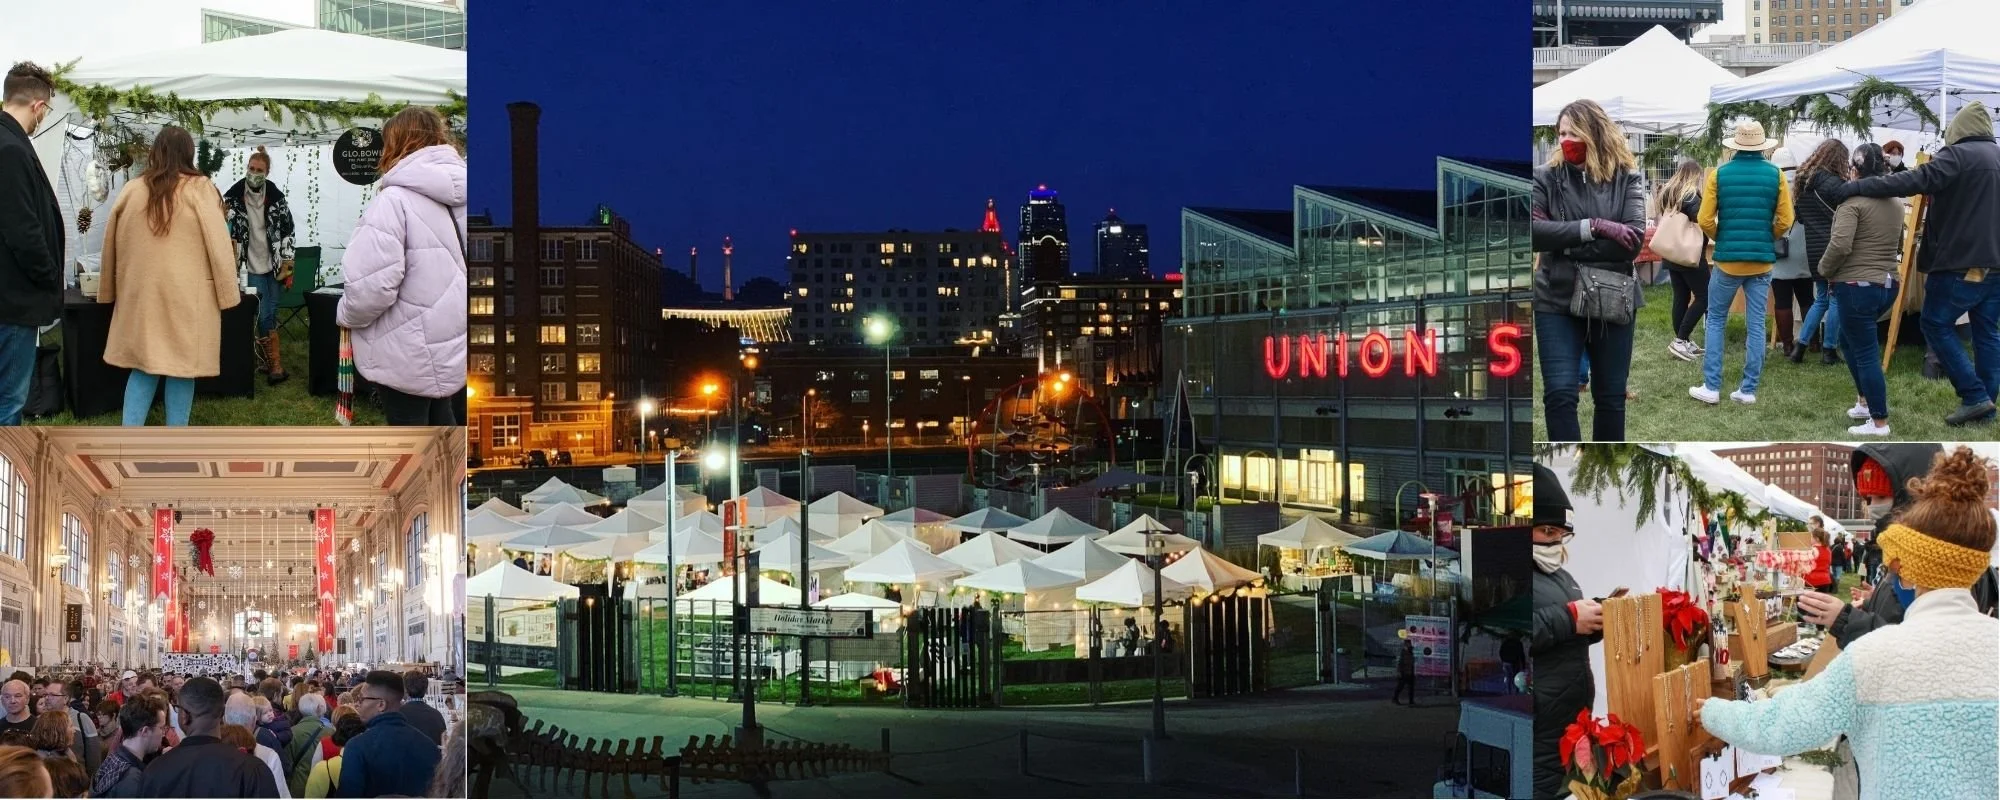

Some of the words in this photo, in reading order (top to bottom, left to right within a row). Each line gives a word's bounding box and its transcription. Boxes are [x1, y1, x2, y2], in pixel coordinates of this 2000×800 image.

[1264, 328, 1437, 378] UNION
[1488, 323, 1521, 377] S
[774, 614, 803, 624] Holiday
[805, 615, 833, 625] Market
